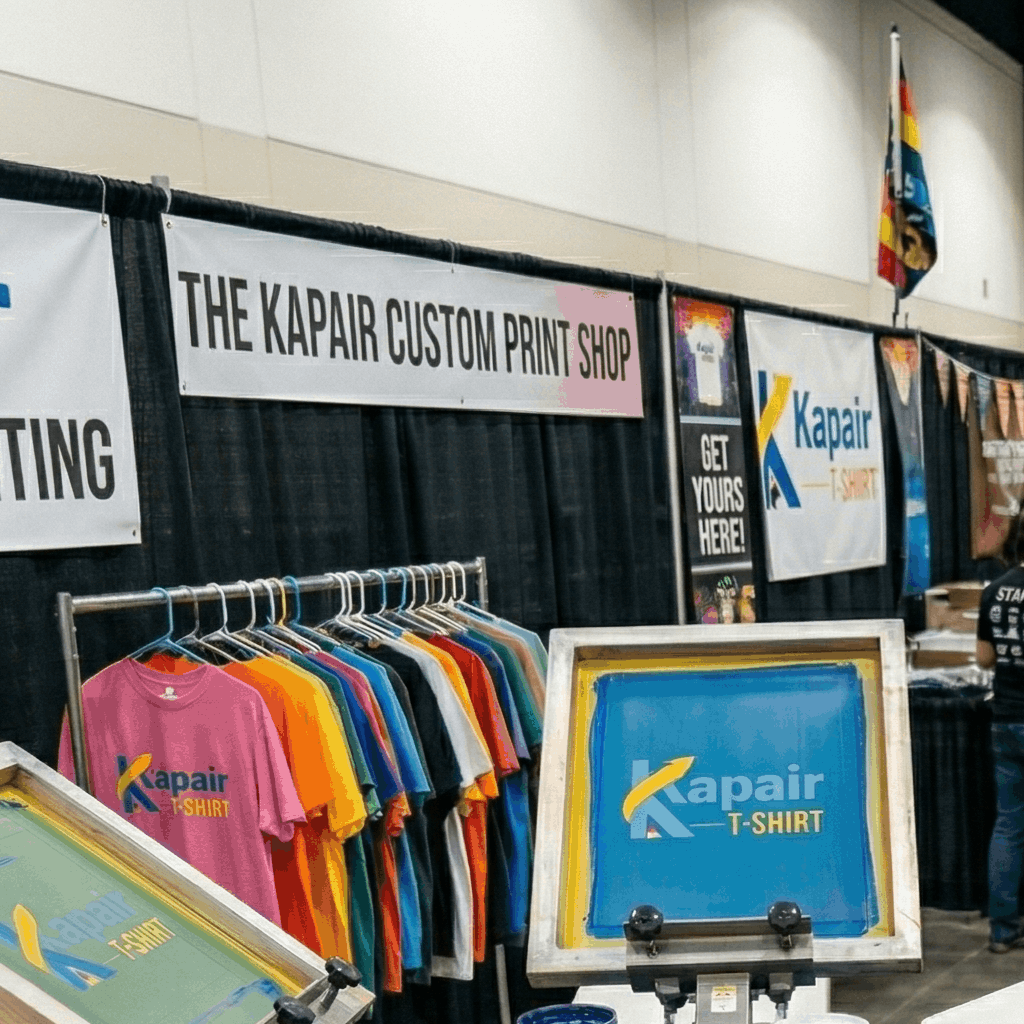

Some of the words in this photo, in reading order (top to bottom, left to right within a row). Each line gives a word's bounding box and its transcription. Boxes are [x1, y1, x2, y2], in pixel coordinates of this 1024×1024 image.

[178, 271, 253, 352] THE
[259, 281, 379, 362] KAPAIR
[386, 298, 498, 372] CUSTOM
[503, 312, 570, 377] PRINT
[577, 322, 631, 381] SHOP
[793, 390, 872, 461] Kapair
[0, 417, 115, 501] TING
[701, 433, 729, 472] GET
[692, 476, 744, 513] YOURS
[699, 517, 745, 556] HERE!
[116, 752, 229, 815] Kapair
[622, 756, 825, 840] Kapair
[171, 797, 230, 818] T-SHIRT
[728, 810, 824, 835] T-SHIRT
[108, 917, 176, 961] T-SHIRT
